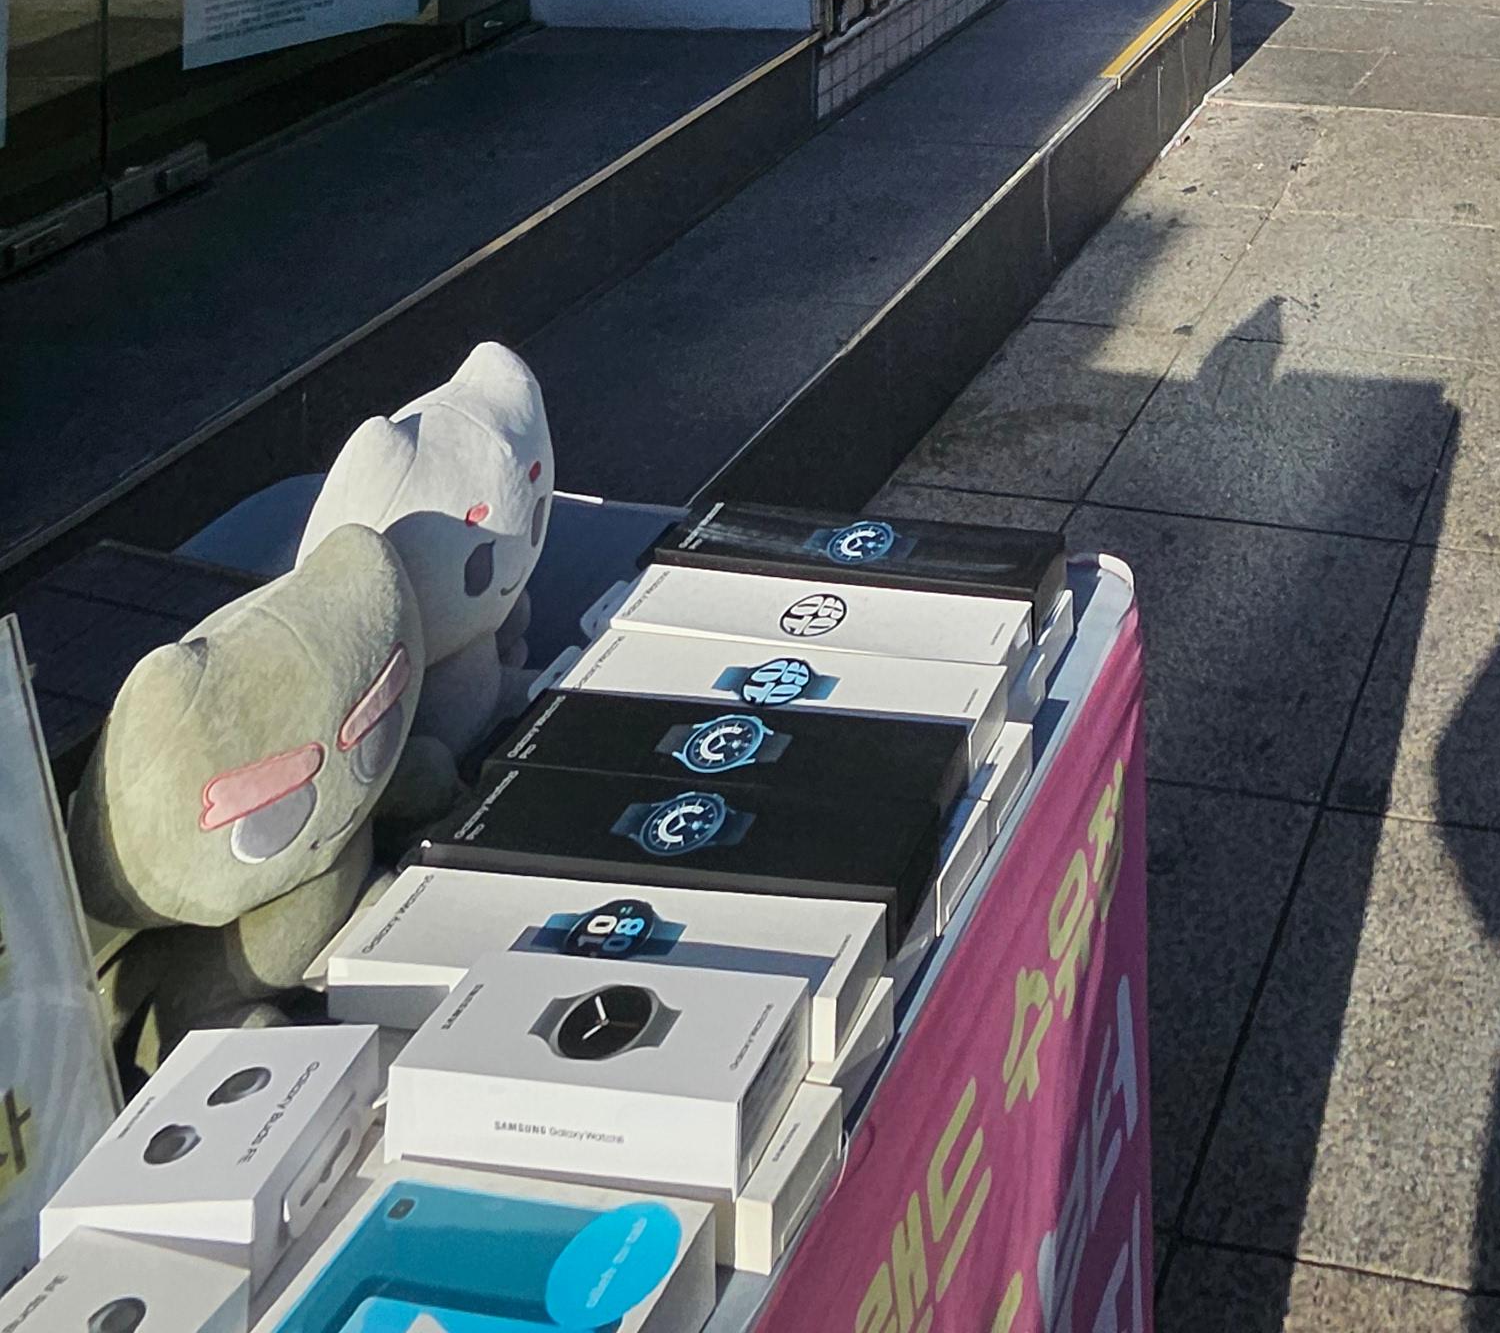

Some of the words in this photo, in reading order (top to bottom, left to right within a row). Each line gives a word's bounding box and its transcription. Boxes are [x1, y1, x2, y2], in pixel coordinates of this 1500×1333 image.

[361, 915, 402, 955] Galaxy
[277, 1061, 320, 1109] Galaxy
[251, 1110, 284, 1147] Buds
[494, 1120, 547, 1135] SAMSUNG
[549, 1126, 585, 1142] Galaxy
